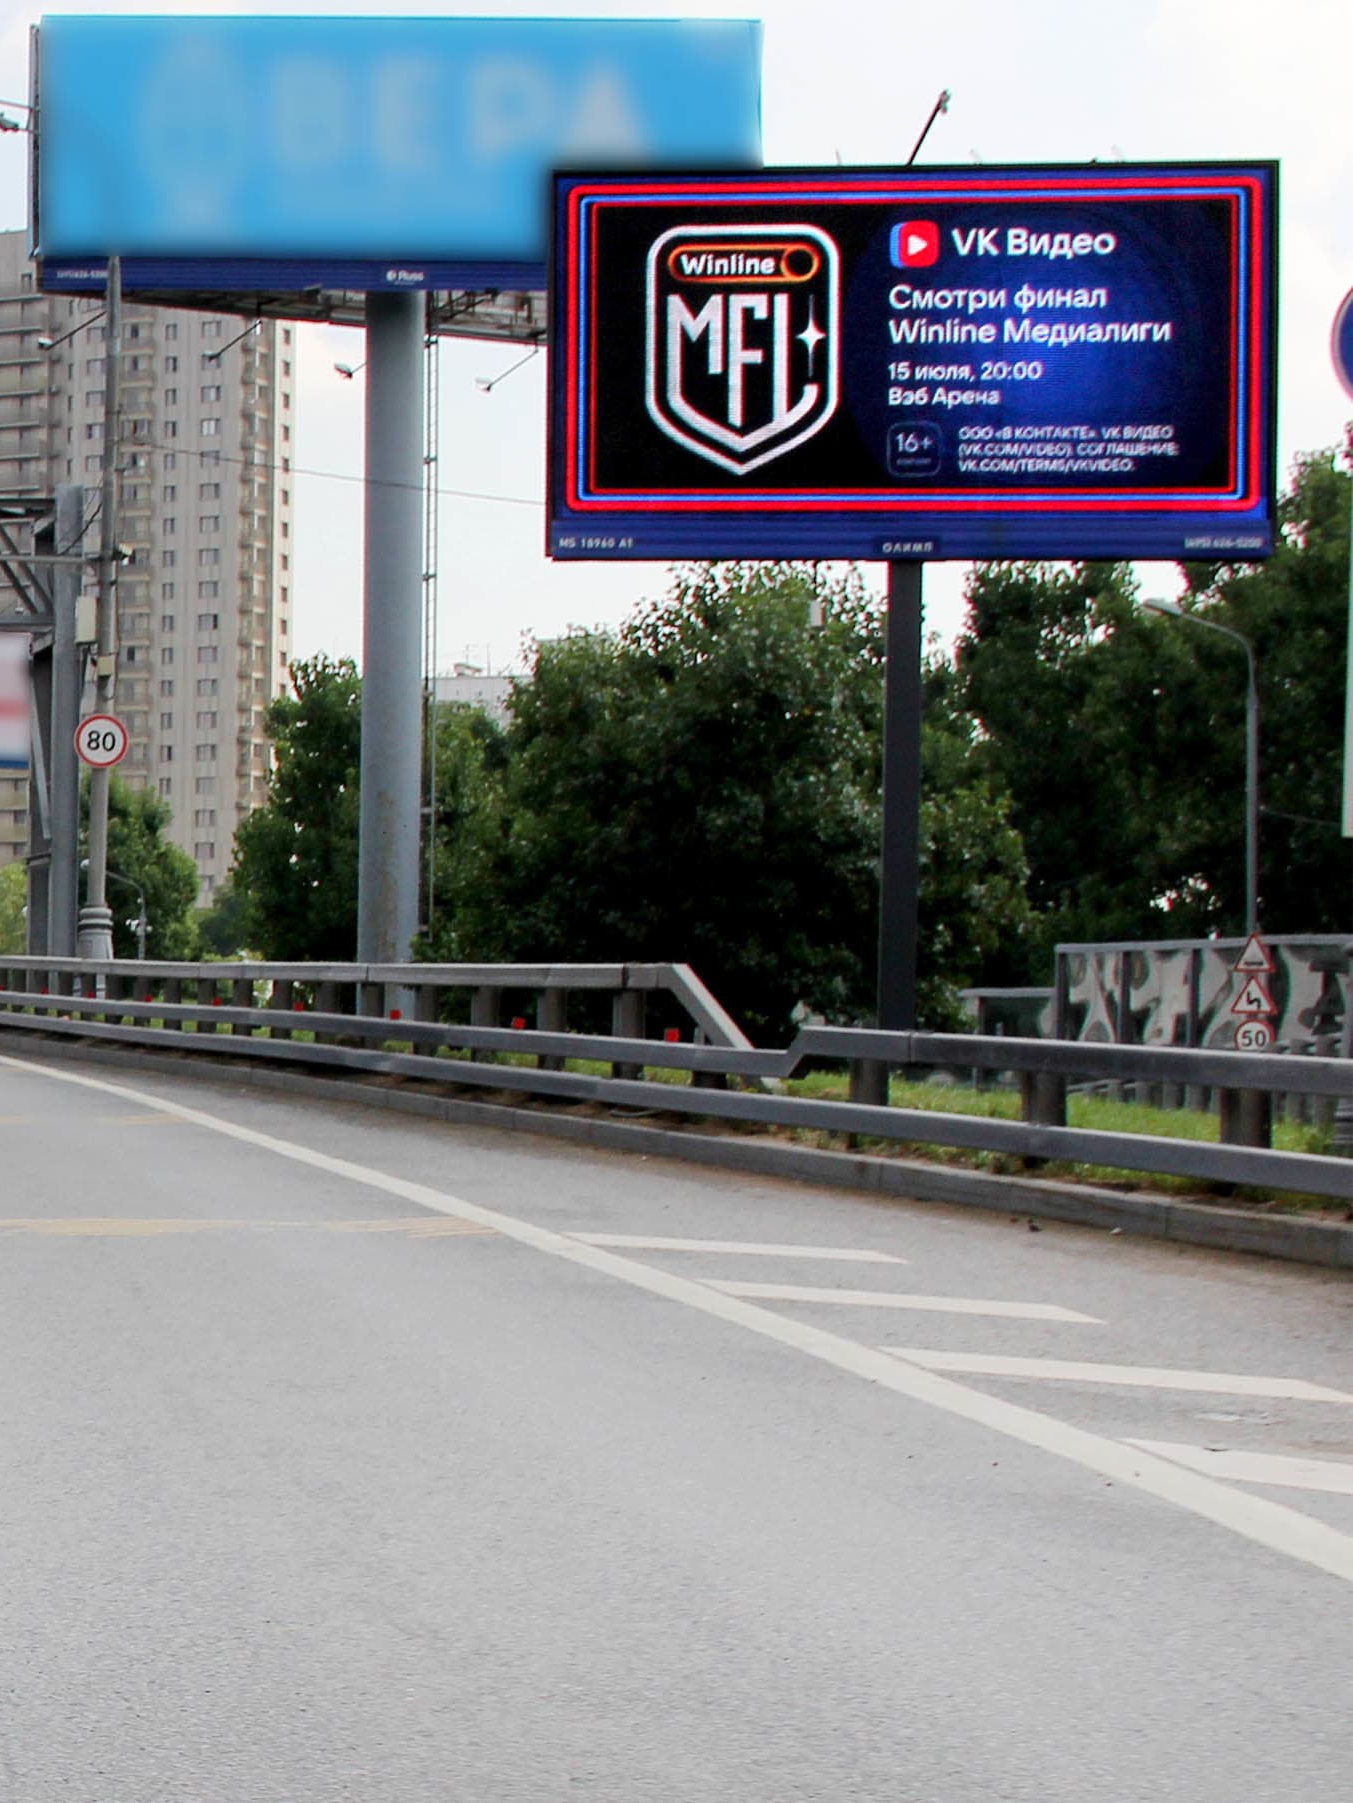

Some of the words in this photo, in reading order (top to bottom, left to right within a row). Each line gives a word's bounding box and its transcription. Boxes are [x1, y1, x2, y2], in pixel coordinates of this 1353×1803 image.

[951, 228, 999, 256] VK
[1006, 228, 1117, 259] Видео
[679, 253, 776, 275] Winline
[888, 284, 1007, 314] Смотри
[1013, 284, 1109, 313] финал
[888, 319, 997, 344] Winline
[1003, 319, 1174, 347] Медиалиги
[666, 293, 819, 450] MFL
[888, 362, 910, 380] 15
[914, 364, 976, 382] июля,
[980, 361, 1044, 380] 20:00
[888, 387, 928, 405] Вэб
[931, 388, 1001, 409] Арена
[896, 432, 934, 452] 16+
[958, 426, 994, 440] ООО
[1101, 426, 1121, 440] VK
[1123, 425, 1175, 441] ВИДЕО
[87, 730, 116, 752] 80
[1242, 1030, 1266, 1047] 50
